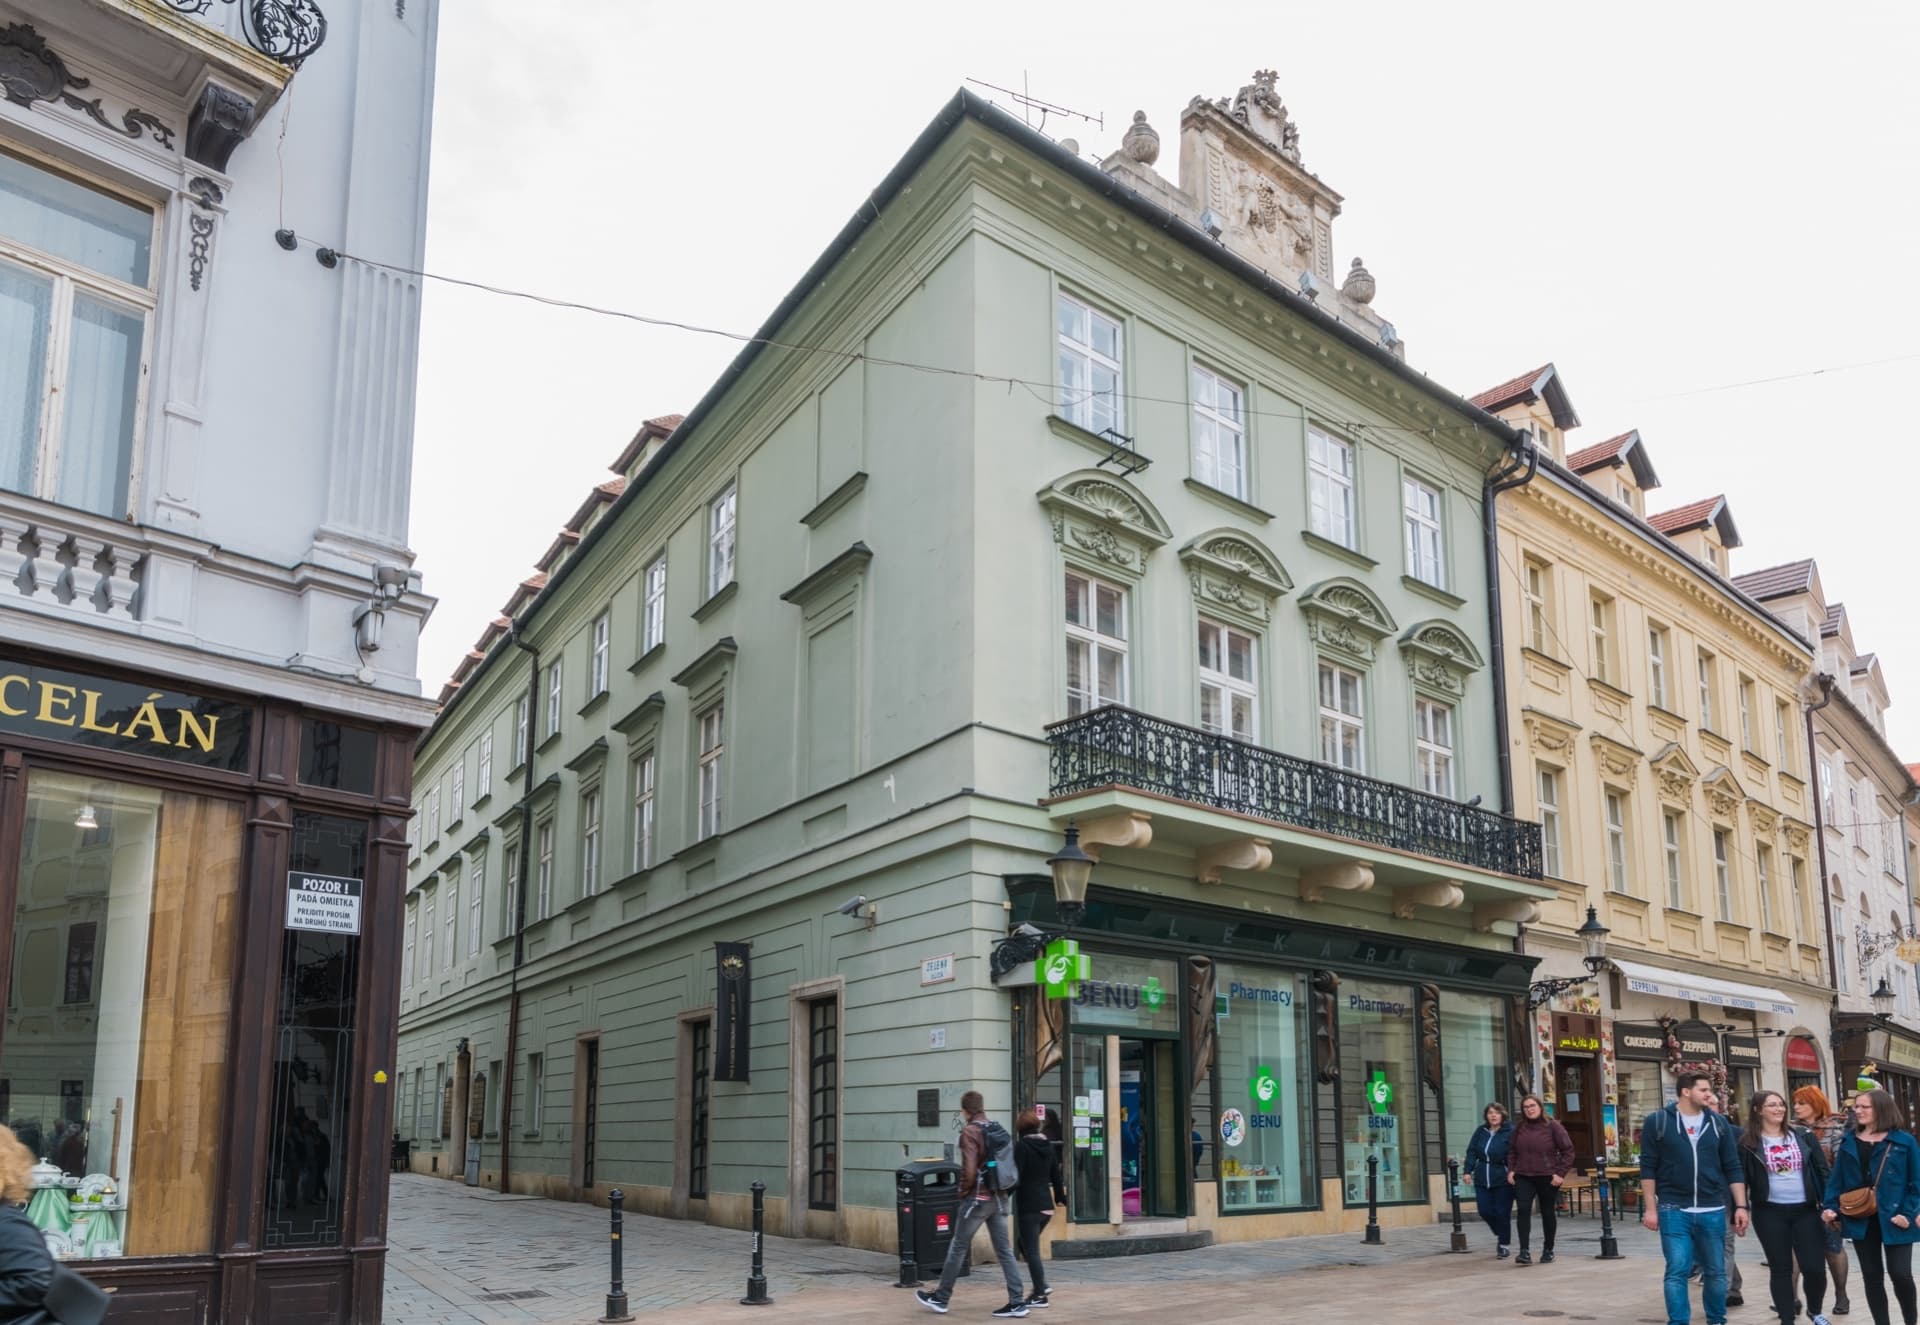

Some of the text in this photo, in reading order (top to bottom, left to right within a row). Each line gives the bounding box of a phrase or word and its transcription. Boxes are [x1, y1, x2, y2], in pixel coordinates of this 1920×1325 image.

[0, 674, 220, 753] CELÁN
[302, 878, 342, 894] POZOR
[296, 893, 354, 908] PADÁ OMIETKA
[326, 909, 351, 919] PROSÍM
[328, 920, 353, 929] STRANU
[1631, 980, 1659, 993] ZEPPELIN
[1072, 980, 1139, 1010] BENU
[1230, 982, 1293, 1007] Pharmacy
[1350, 995, 1405, 1016] Pharmacy
[1624, 1035, 1663, 1049] CAKESHOP
[1682, 1041, 1717, 1054] ZEPPELIN
[1250, 1114, 1281, 1128] BENU
[1368, 1115, 1395, 1129] BENU
